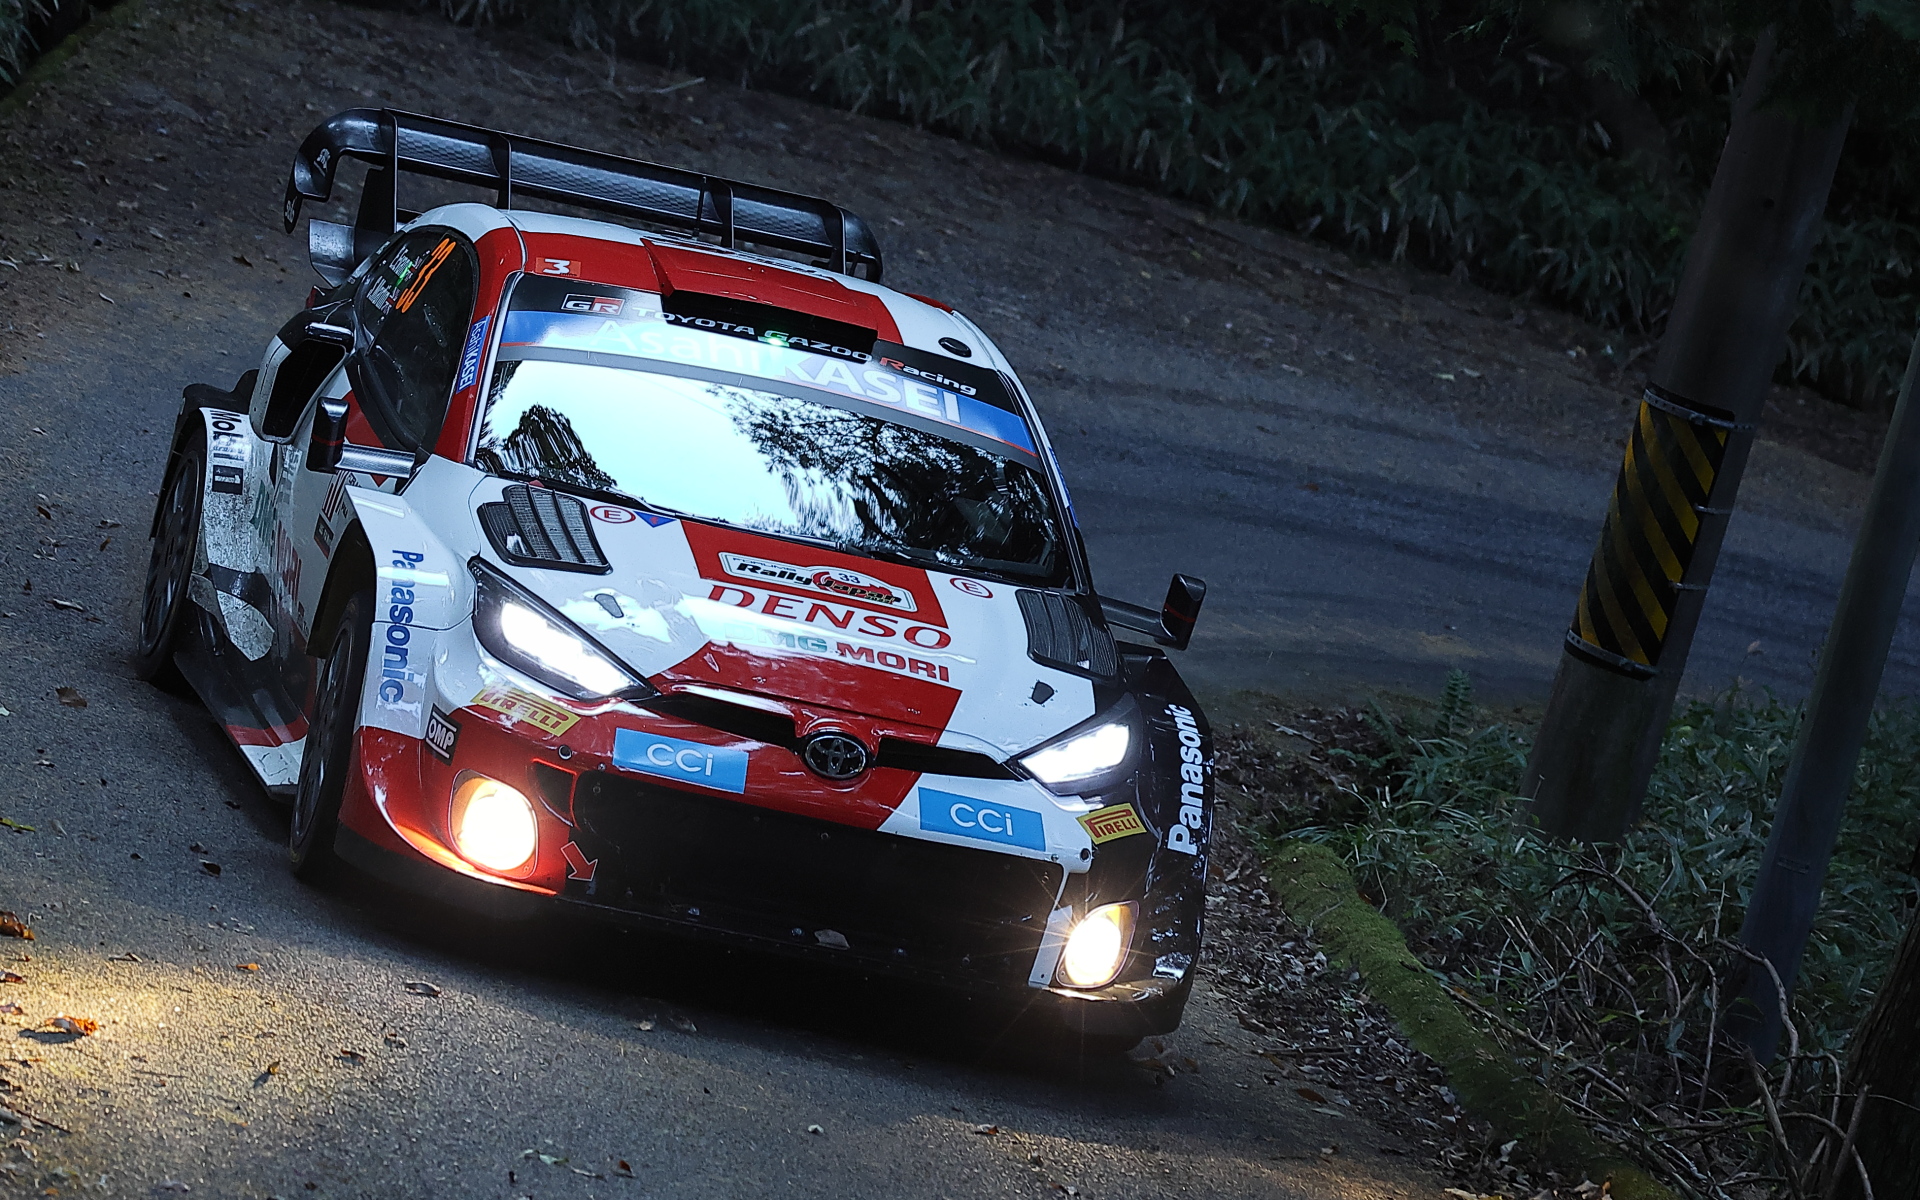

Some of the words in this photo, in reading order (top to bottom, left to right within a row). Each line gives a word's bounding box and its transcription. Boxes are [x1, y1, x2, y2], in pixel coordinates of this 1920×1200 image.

[543, 258, 571, 275] 3
[566, 297, 622, 314] GR
[632, 307, 755, 335] TOYOTA
[763, 330, 873, 363] GAZOO
[879, 356, 977, 396] Racing
[737, 563, 812, 585] Rally
[817, 579, 901, 603] Japan
[838, 573, 860, 584] 33
[379, 550, 424, 703] Panasonic
[708, 584, 951, 649] DENSO
[725, 622, 828, 653] DMG
[836, 641, 950, 683] MORI
[480, 685, 569, 730] PIRELLI
[428, 718, 455, 751] OMP
[1164, 703, 1204, 856] Panasonic
[1083, 808, 1140, 839] PIRELLI
